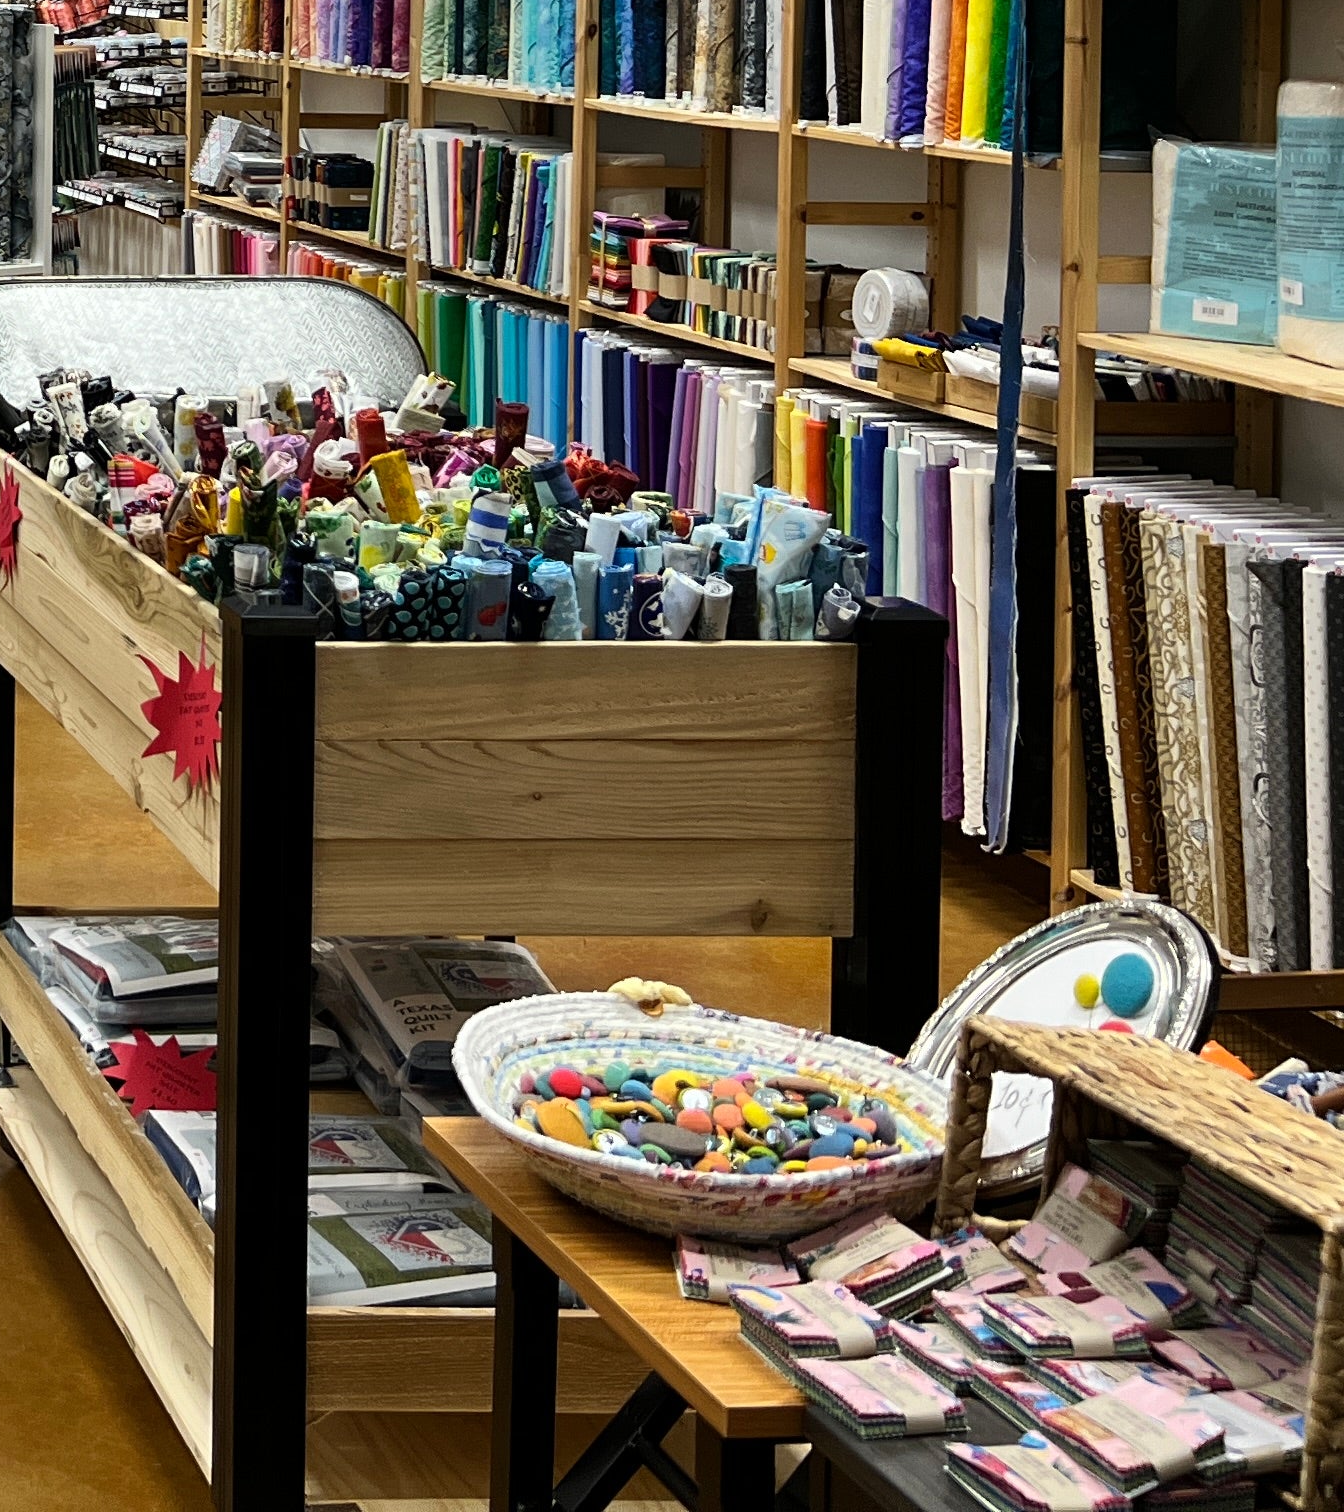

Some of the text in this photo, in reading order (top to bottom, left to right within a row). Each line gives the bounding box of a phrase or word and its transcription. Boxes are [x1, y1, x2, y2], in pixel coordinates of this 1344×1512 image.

[393, 999, 406, 1007] A
[396, 1004, 454, 1015] TEXAS
[404, 1013, 452, 1025] QUILT
[409, 1023, 436, 1034] KIT
